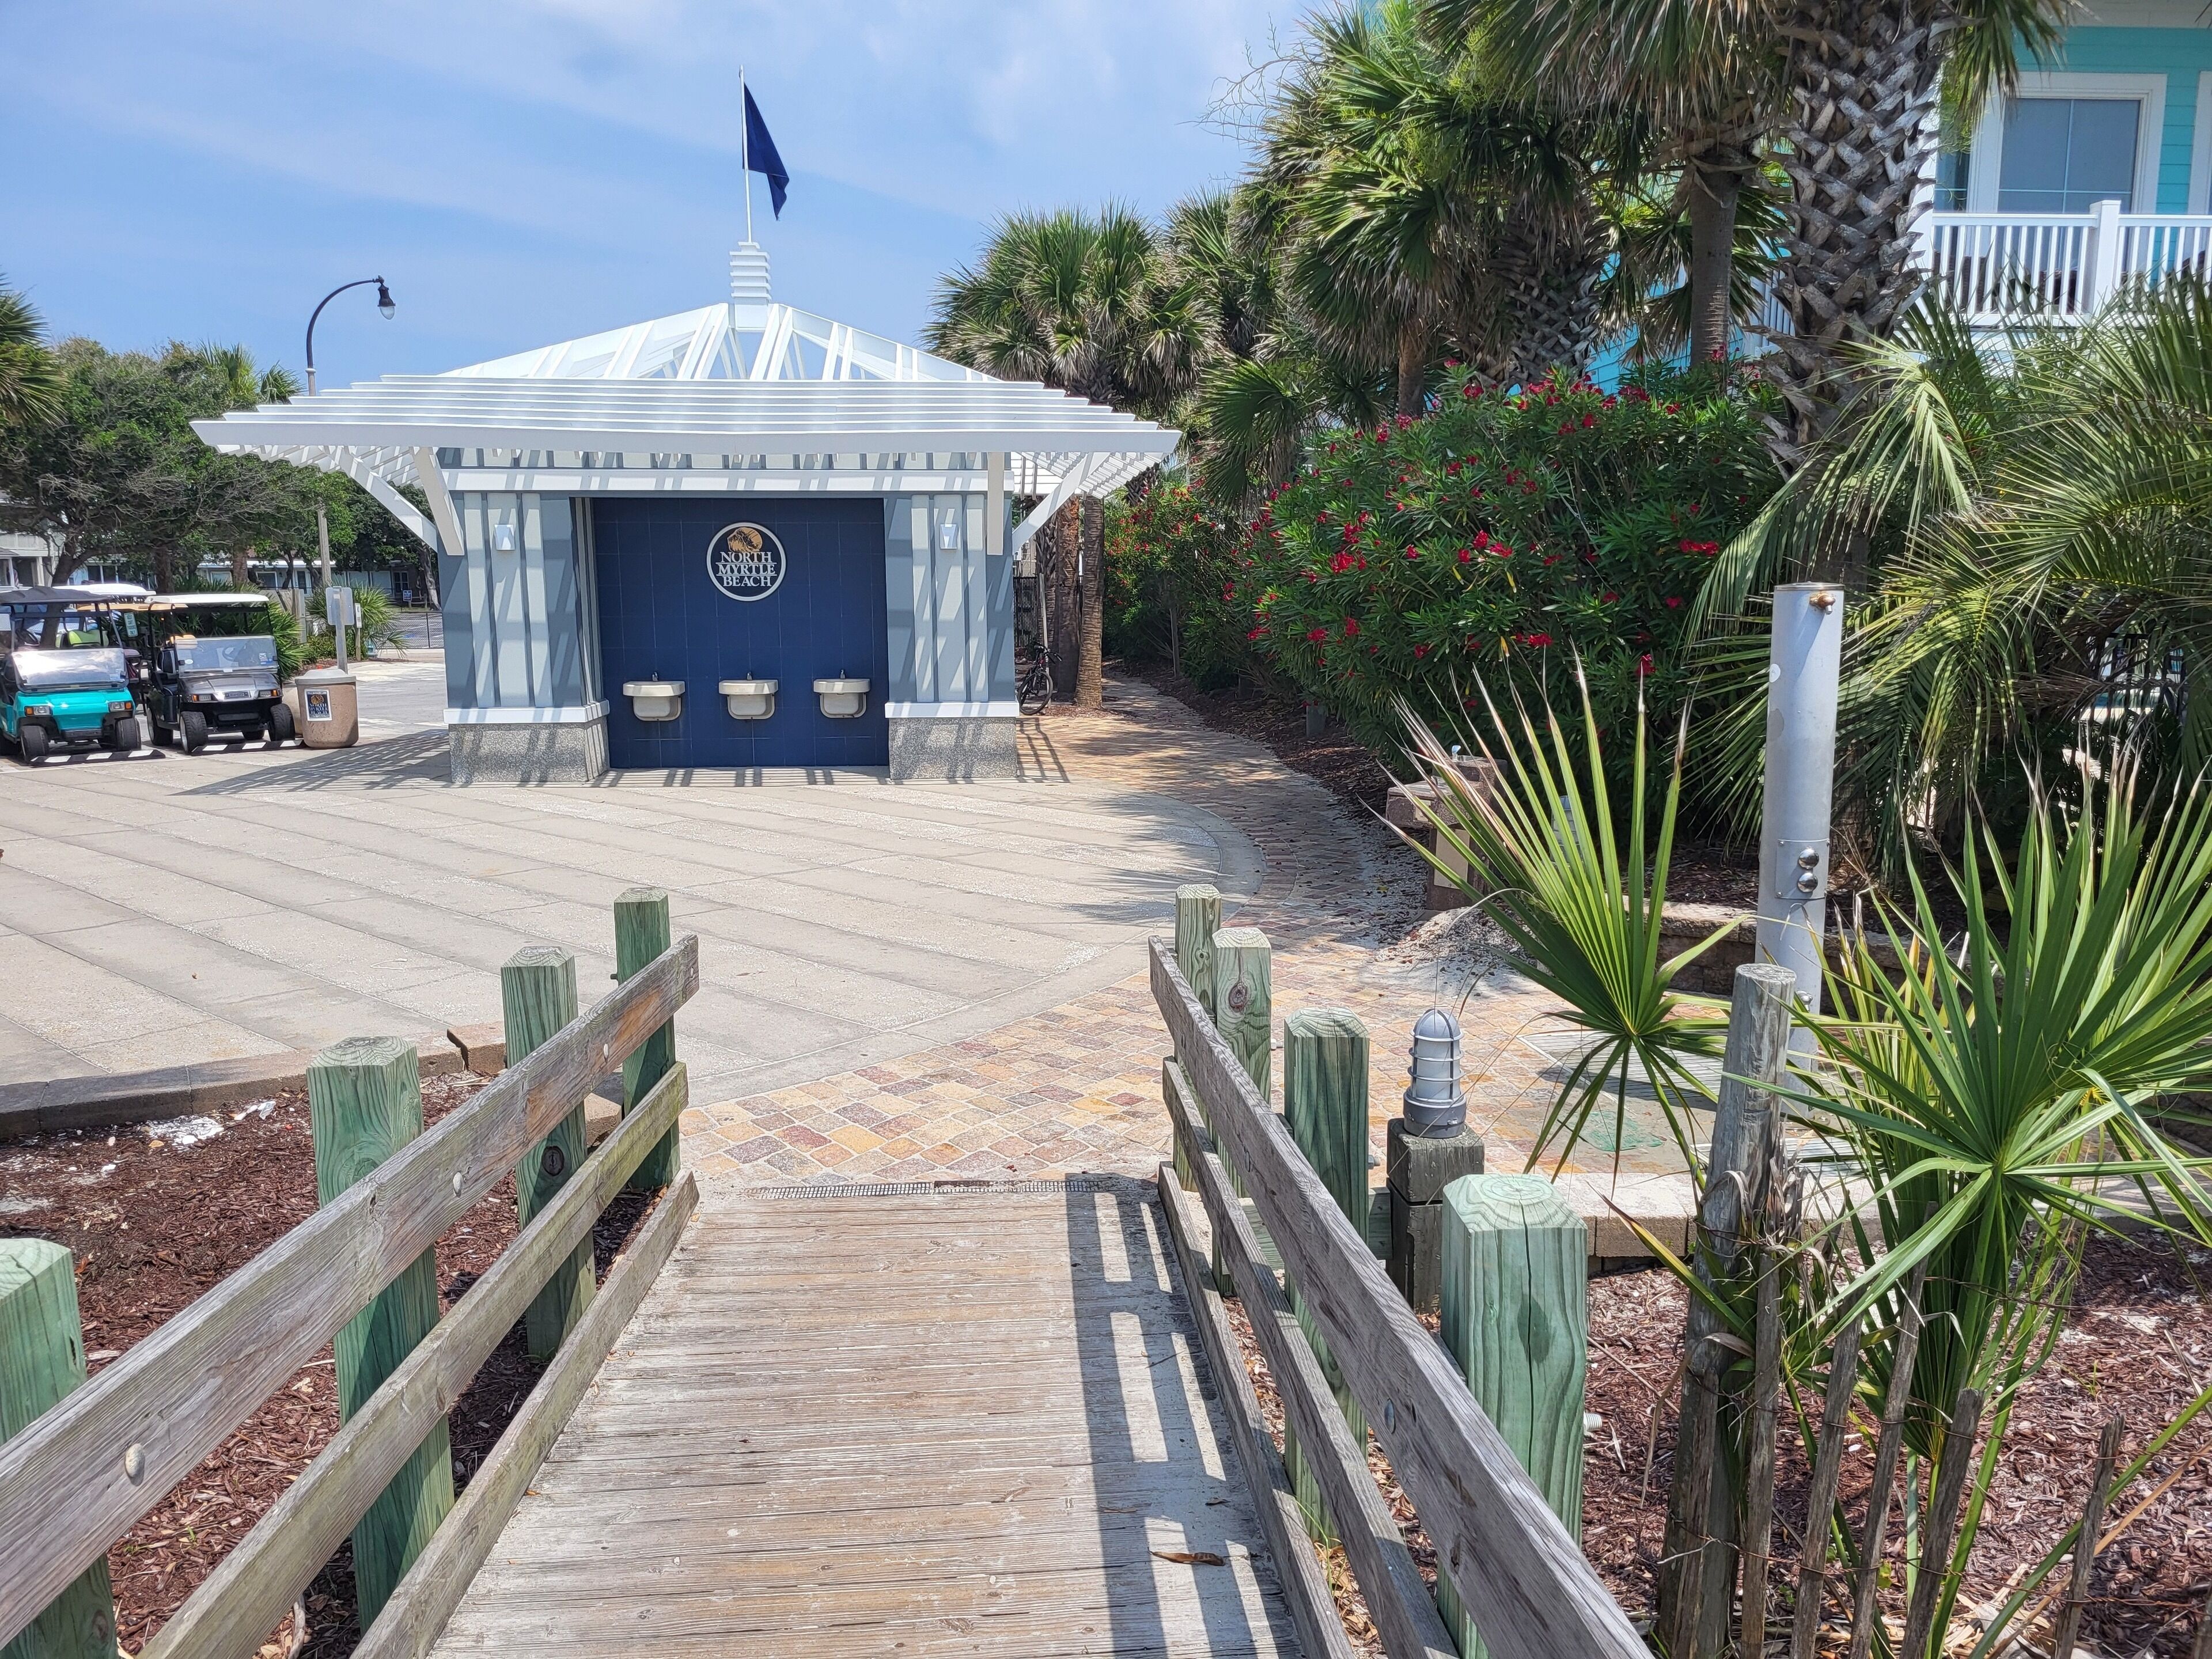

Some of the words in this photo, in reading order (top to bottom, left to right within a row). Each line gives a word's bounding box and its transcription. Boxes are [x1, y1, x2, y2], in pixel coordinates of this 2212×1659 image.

[720, 551, 772, 563] NORTH
[717, 564, 775, 574] MYRTLE
[722, 576, 772, 586] BEACH
